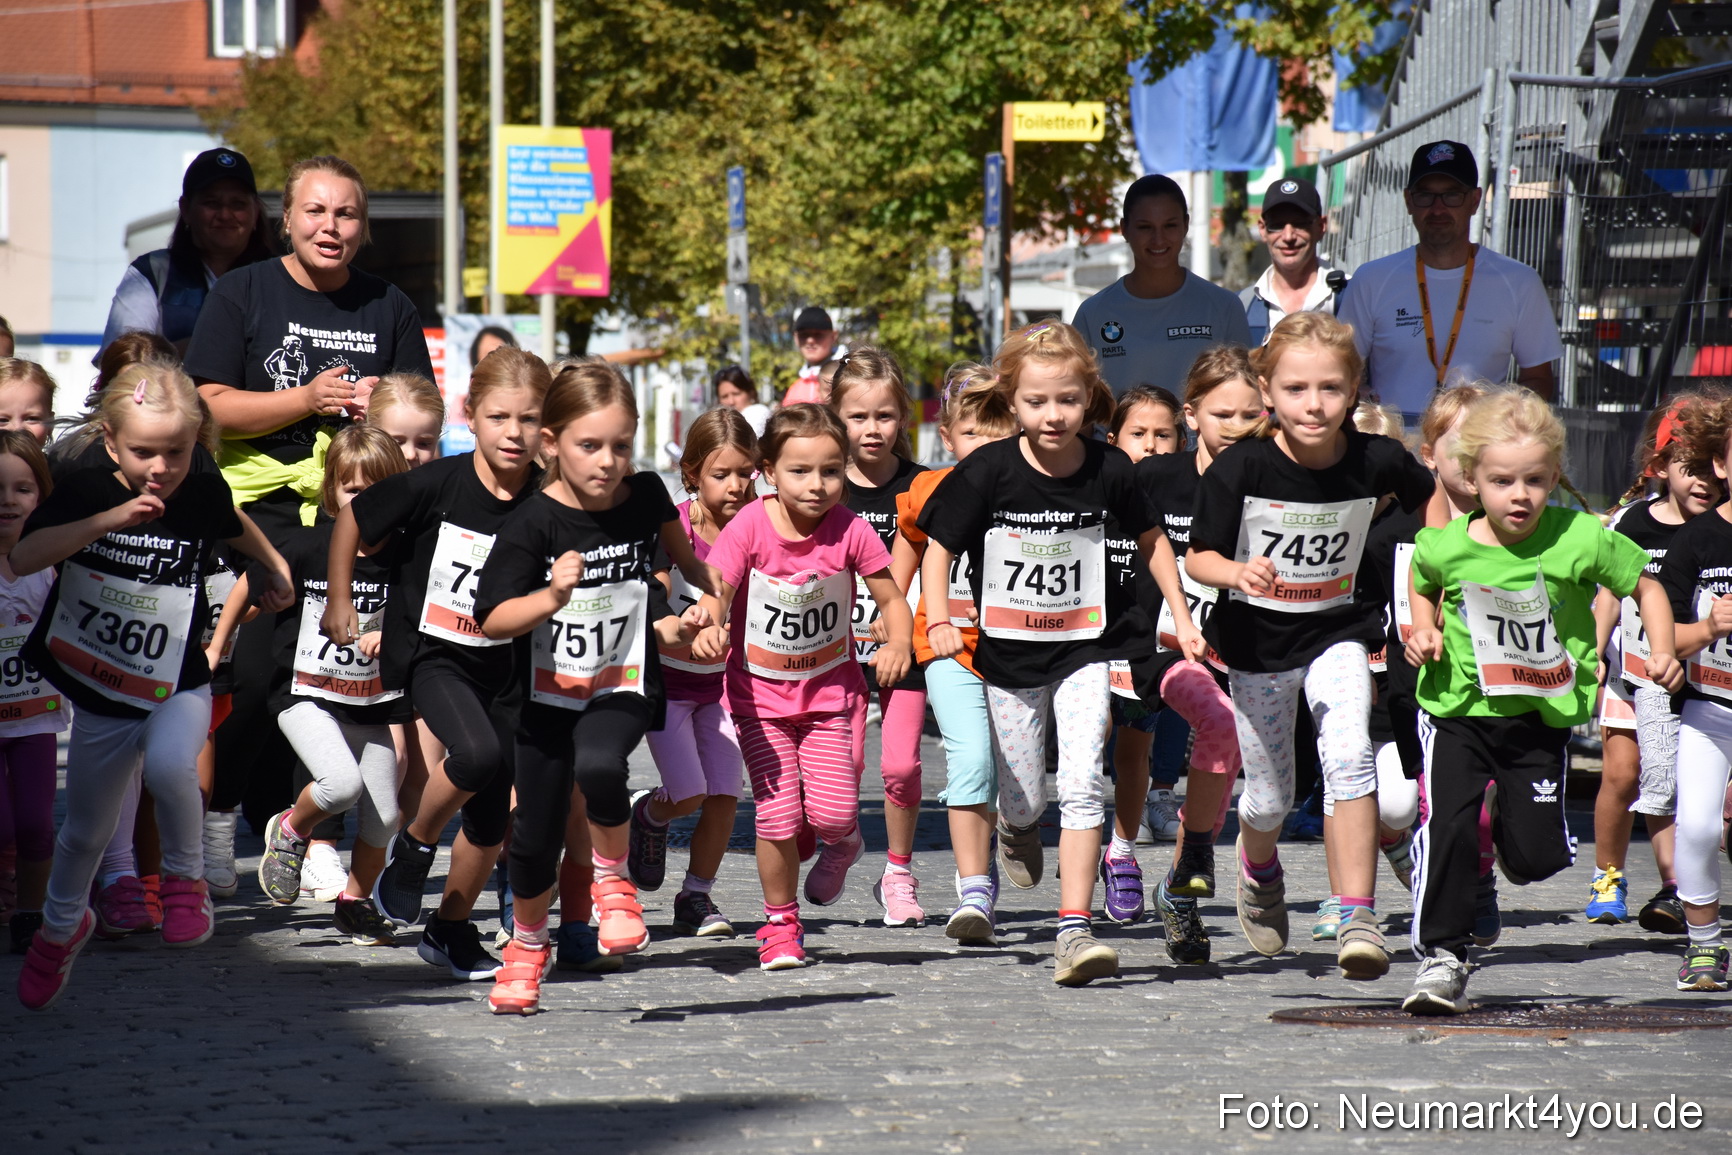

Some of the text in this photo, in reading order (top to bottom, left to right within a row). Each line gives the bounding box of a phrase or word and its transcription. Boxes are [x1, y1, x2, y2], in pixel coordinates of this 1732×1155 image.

[1015, 114, 1087, 129] Toiletten
[1396, 308, 1409, 316] 16.
[288, 322, 376, 342] Neumarkter
[1168, 325, 1212, 337] BOCK
[312, 339, 377, 353] STADTLAUF
[993, 510, 1075, 523] Neumarkter
[1283, 512, 1339, 525] BOCK
[103, 532, 174, 550] umarkter
[1022, 541, 1071, 555] BOCK
[1261, 530, 1350, 566] 7432
[1004, 560, 1081, 596] 7431
[101, 586, 159, 611] BOCK
[778, 587, 825, 604] BOCK
[1274, 585, 1321, 599] Emma
[1010, 598, 1071, 608] PARTL Neumarkt
[1495, 596, 1543, 613] BOCK
[456, 616, 485, 635] The
[764, 601, 838, 641] 7500
[1025, 614, 1064, 628] Luise
[78, 600, 168, 660] 7360
[548, 615, 629, 659] 7517
[767, 638, 825, 651] PARTL Neumarkt
[78, 636, 141, 671] PARTL Neumarkt
[1504, 652, 1562, 665] PARTL Neumarkt
[319, 666, 343, 675] PARTL
[553, 660, 577, 672] PARTL
[783, 655, 818, 670] Julia
[91, 662, 124, 689] Leni
[1512, 666, 1571, 686] Mathilda
[311, 675, 373, 696] SARAH
